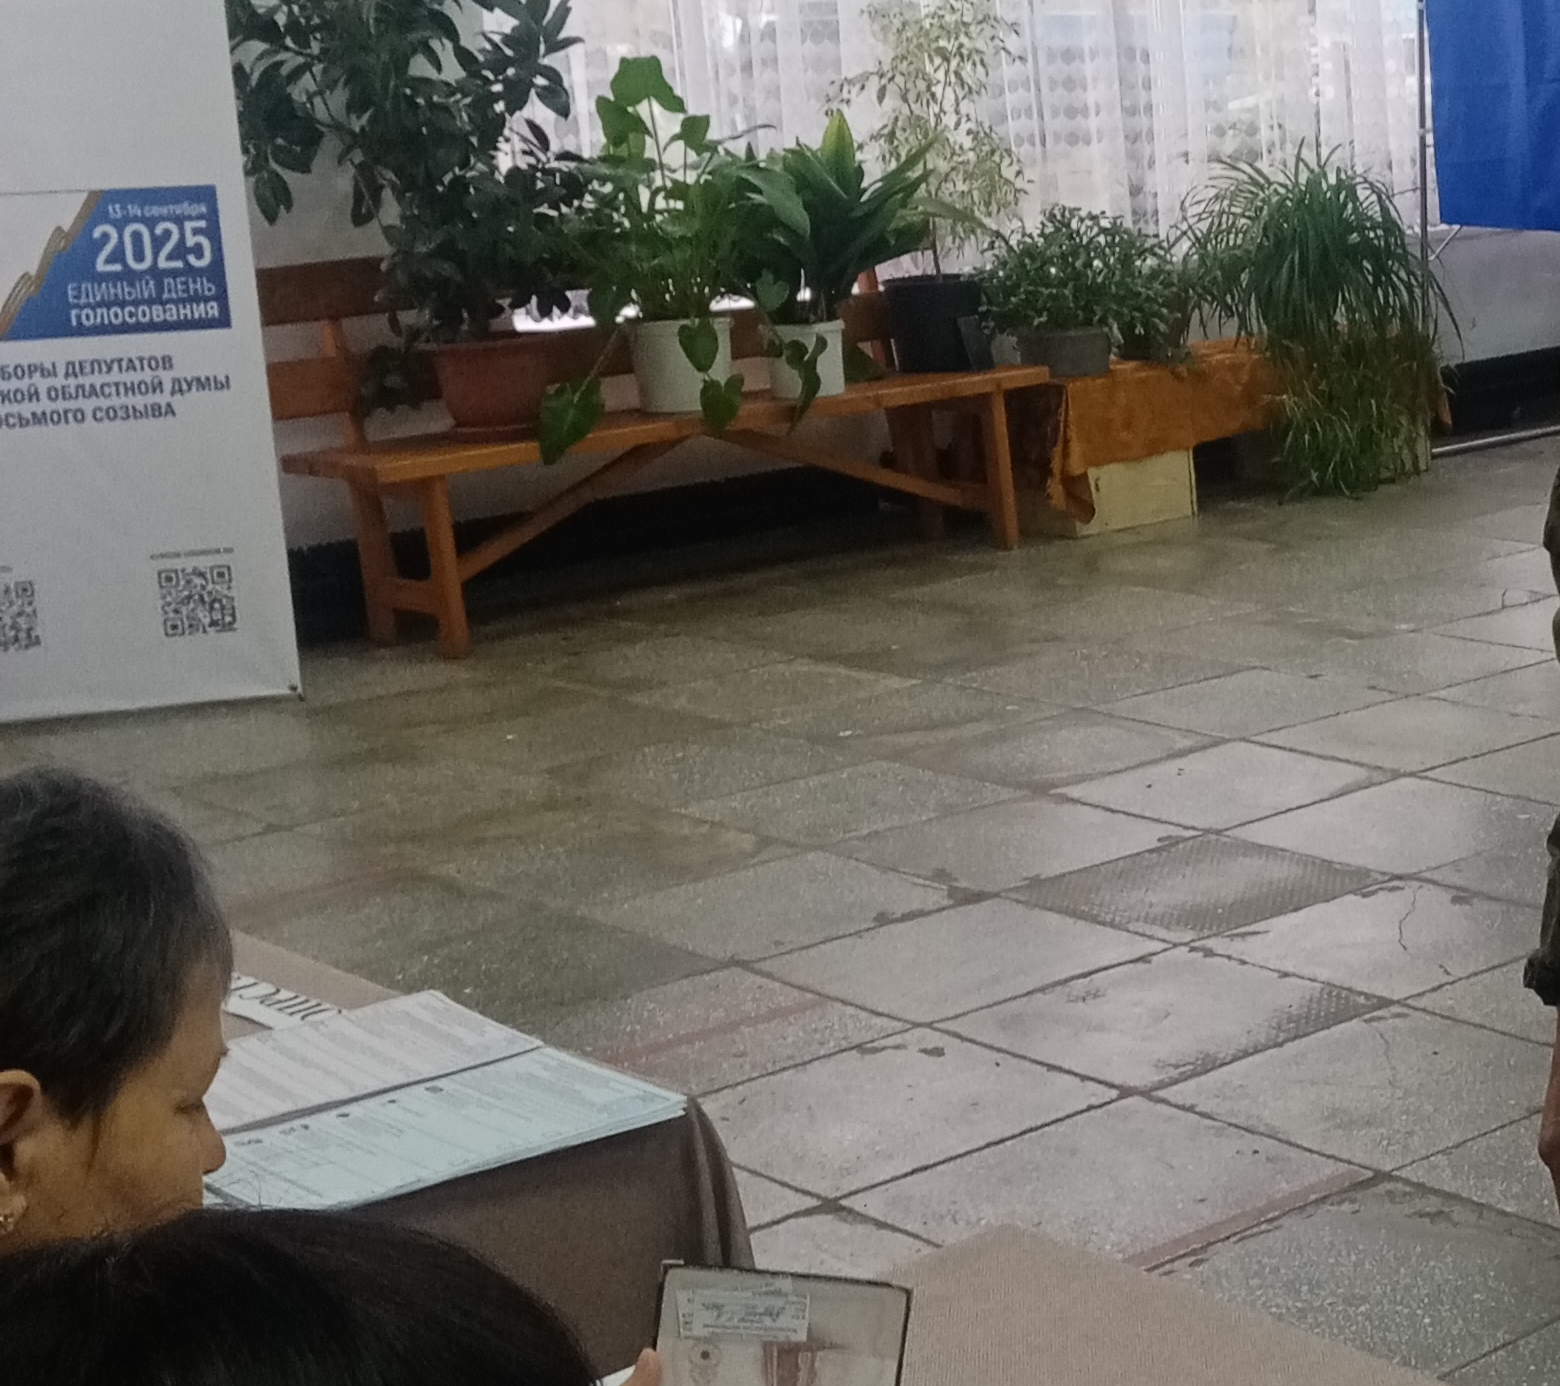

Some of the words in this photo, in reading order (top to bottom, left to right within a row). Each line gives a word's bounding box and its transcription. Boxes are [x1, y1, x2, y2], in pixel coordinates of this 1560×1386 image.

[92, 219, 213, 272] 2025
[67, 275, 157, 304] ЕДИНЫЙ
[162, 276, 216, 300] ДЕНЬ
[70, 300, 219, 327] голосования
[64, 354, 174, 380] ДЕПУТАТОВ
[46, 375, 163, 402] ОБЛАСТНОЙ
[170, 374, 231, 396] ДУМЫ
[0, 404, 86, 429] СЬМОГО
[91, 401, 177, 422] СОЗЫВА
